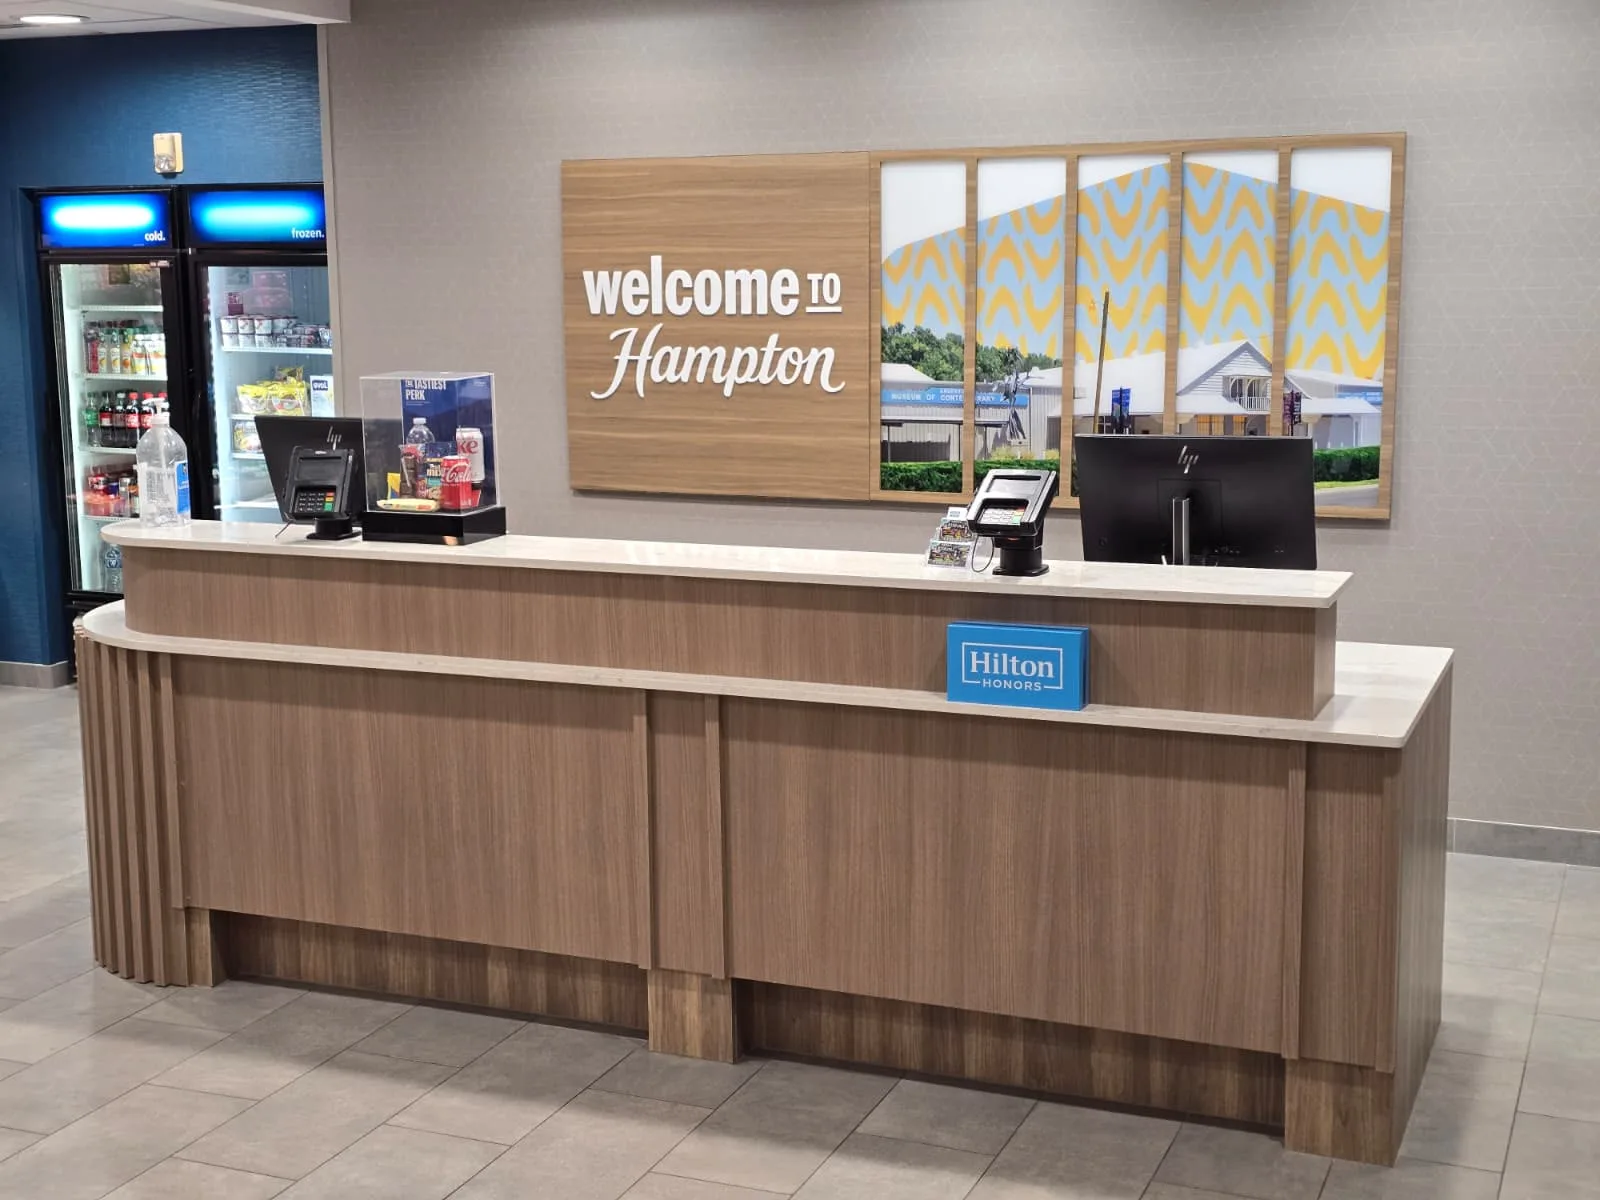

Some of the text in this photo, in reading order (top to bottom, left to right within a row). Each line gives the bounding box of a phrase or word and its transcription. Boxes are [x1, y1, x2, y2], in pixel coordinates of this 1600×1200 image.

[144, 230, 166, 241] cold.
[291, 228, 325, 238] frozen.
[582, 255, 842, 316] welcome TO
[590, 323, 846, 400] Hampton
[414, 378, 447, 390] TASTIEST
[405, 389, 425, 401] PERK
[926, 393, 936, 401] OF
[970, 651, 1055, 679] Hilton
[982, 678, 1042, 692] HONORS
